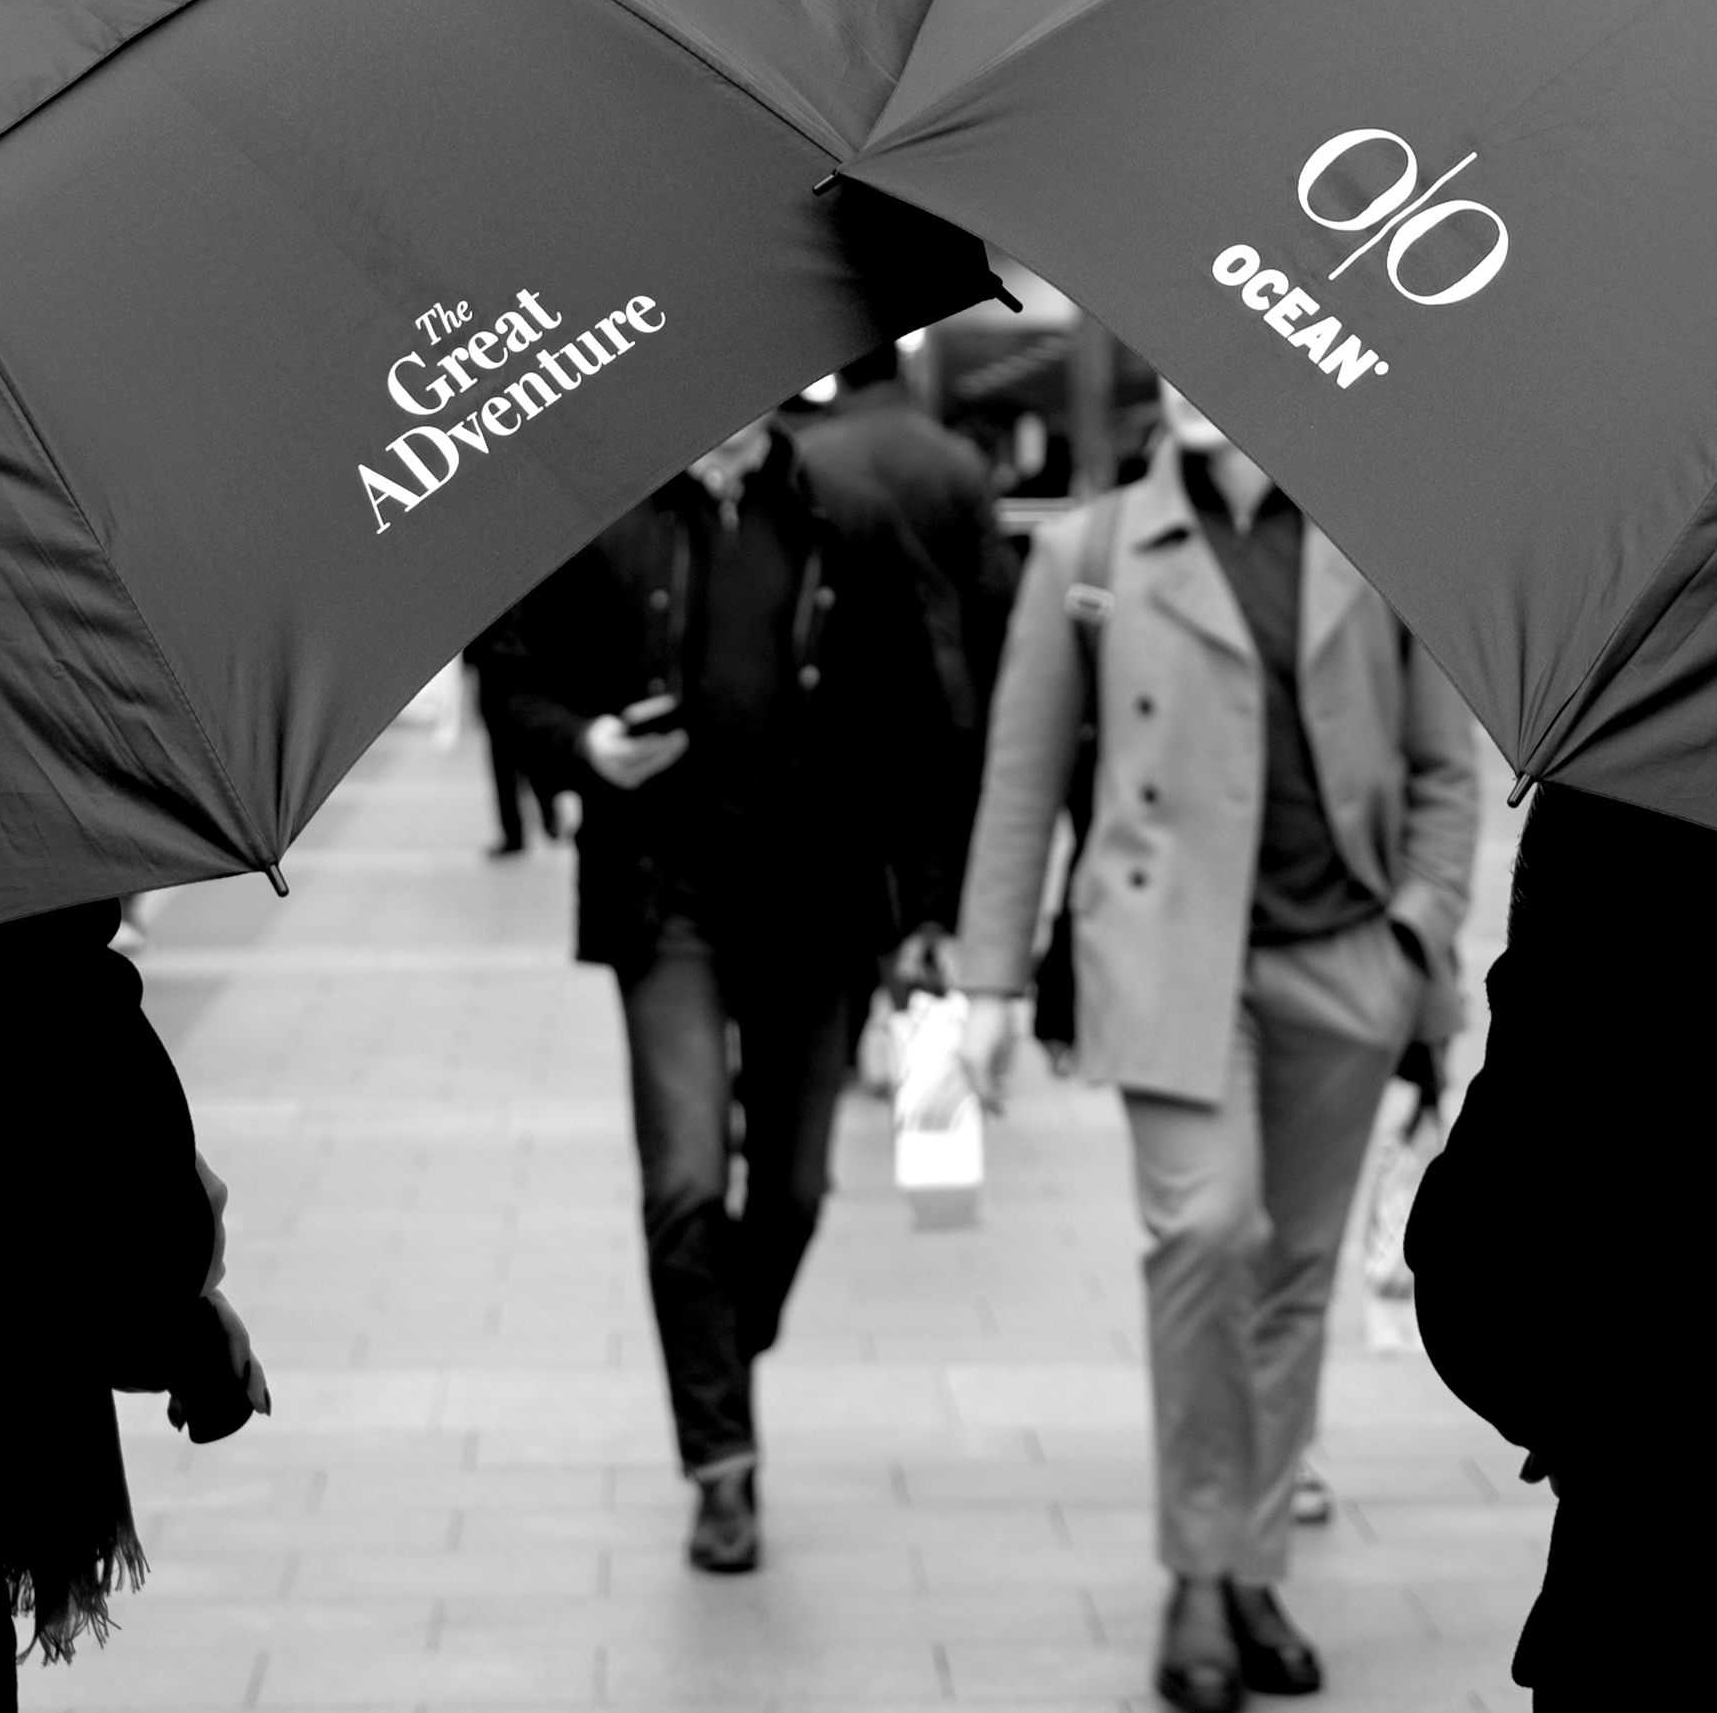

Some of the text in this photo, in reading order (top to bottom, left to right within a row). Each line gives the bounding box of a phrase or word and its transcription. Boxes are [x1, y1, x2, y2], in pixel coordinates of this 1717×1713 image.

[387, 288, 563, 416] Great
[415, 300, 473, 346] The
[357, 295, 666, 535] ADventure
